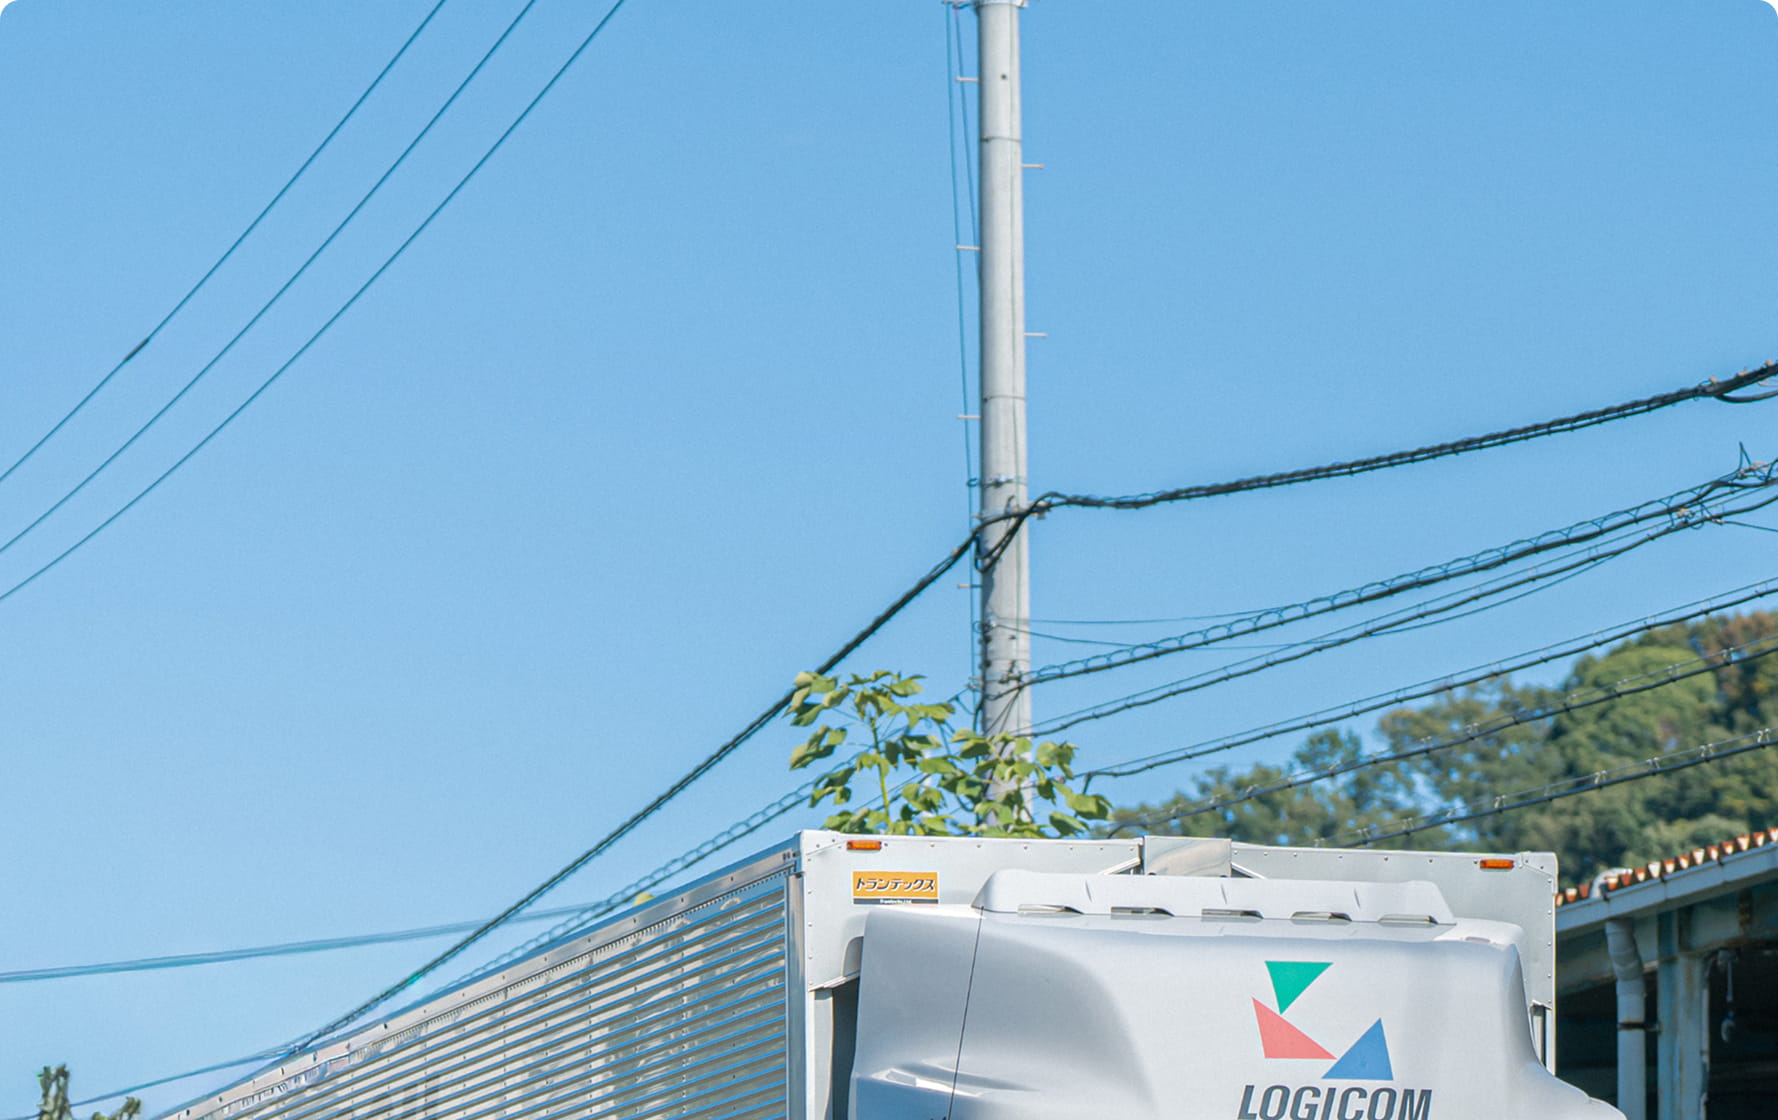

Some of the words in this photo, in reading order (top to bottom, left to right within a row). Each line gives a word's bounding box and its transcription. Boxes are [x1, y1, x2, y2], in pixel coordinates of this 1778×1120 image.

[856, 878, 935, 892] トランテックス
